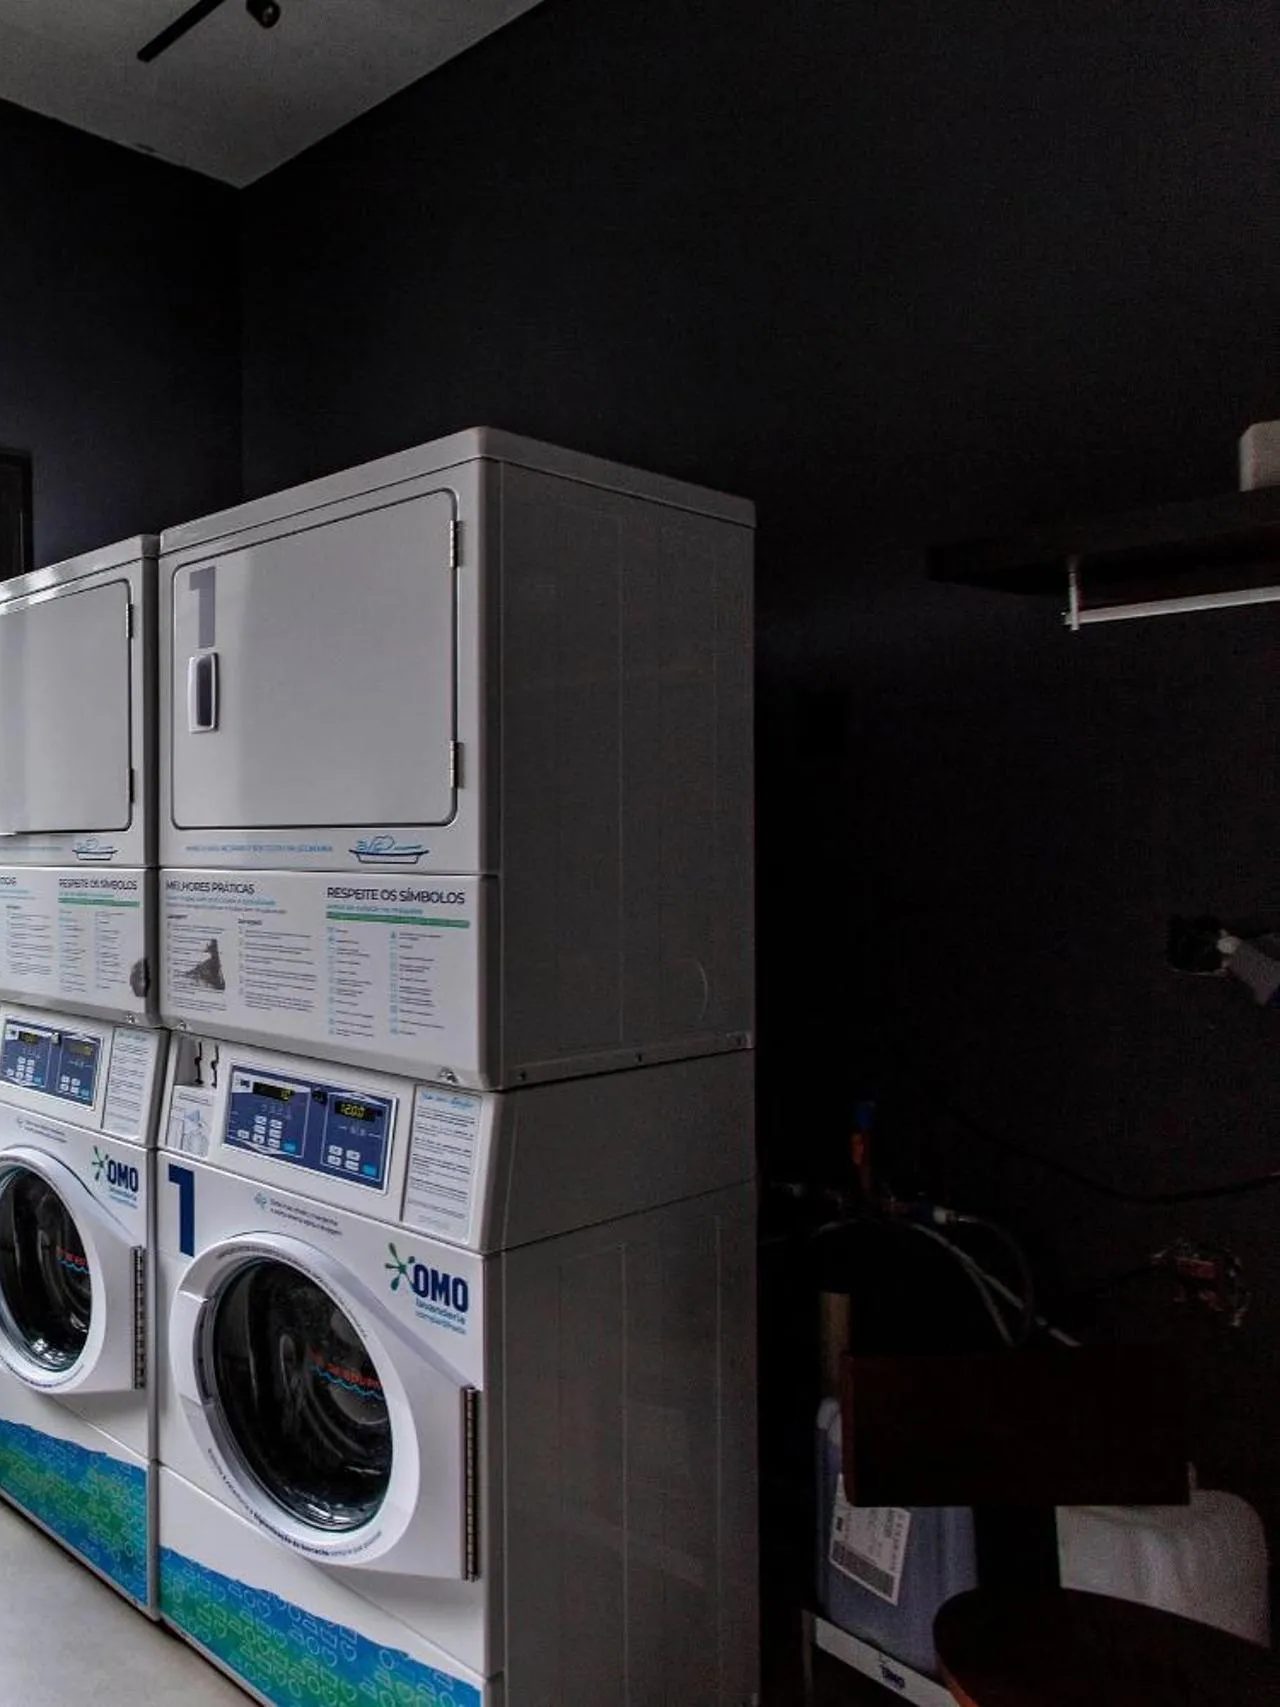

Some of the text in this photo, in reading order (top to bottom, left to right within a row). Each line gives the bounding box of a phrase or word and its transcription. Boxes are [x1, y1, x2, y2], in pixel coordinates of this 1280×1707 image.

[188, 566, 216, 649] 1
[165, 879, 256, 896] MELHORES PRÁTICAS
[327, 886, 466, 905] RESPEITE OS SÍMBOLOS
[107, 1159, 139, 1193] OMO
[168, 1163, 195, 1258] 1
[412, 1263, 469, 1313] OMO
